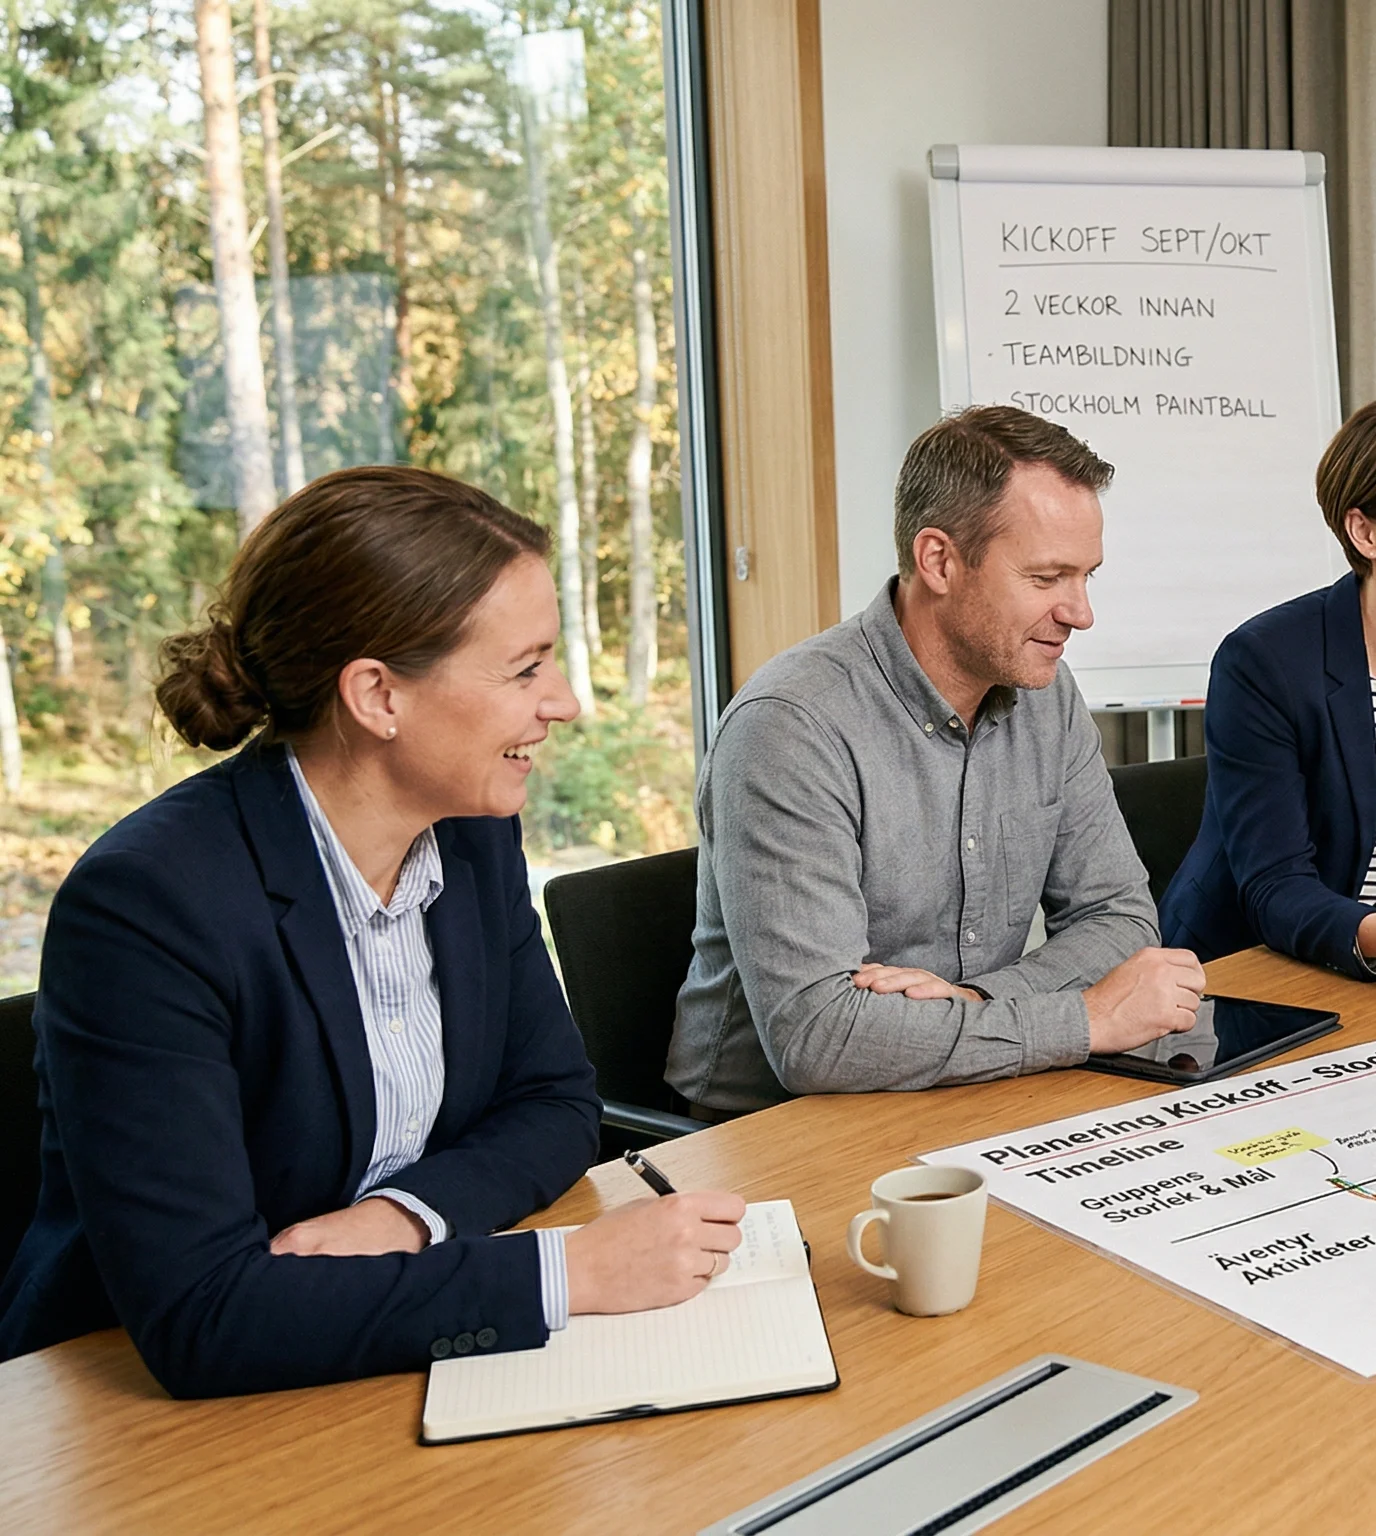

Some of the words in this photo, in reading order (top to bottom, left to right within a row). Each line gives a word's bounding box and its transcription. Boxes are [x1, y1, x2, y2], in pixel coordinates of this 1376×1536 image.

[1001, 222, 1117, 254] KICKOFF
[1140, 222, 1272, 262] SEPT/OKT
[1004, 289, 1021, 316] 2
[1034, 294, 1122, 316] VECKOR
[1139, 297, 1215, 318] INNAN
[1003, 341, 1193, 367] TEAMBILDNING
[1010, 390, 1141, 415] STOCKHOLM
[1156, 394, 1277, 419] PAINTBALL
[979, 1110, 1168, 1166] Planering
[1161, 1078, 1289, 1119] Kickoff
[1025, 1137, 1186, 1185] Timeline
[1080, 1170, 1206, 1211] Gruppens
[1102, 1190, 1203, 1224] Storlek
[1199, 1183, 1227, 1197] &
[1207, 1232, 1316, 1271] Äventyr
[1241, 1234, 1376, 1286] Aktiviteter
